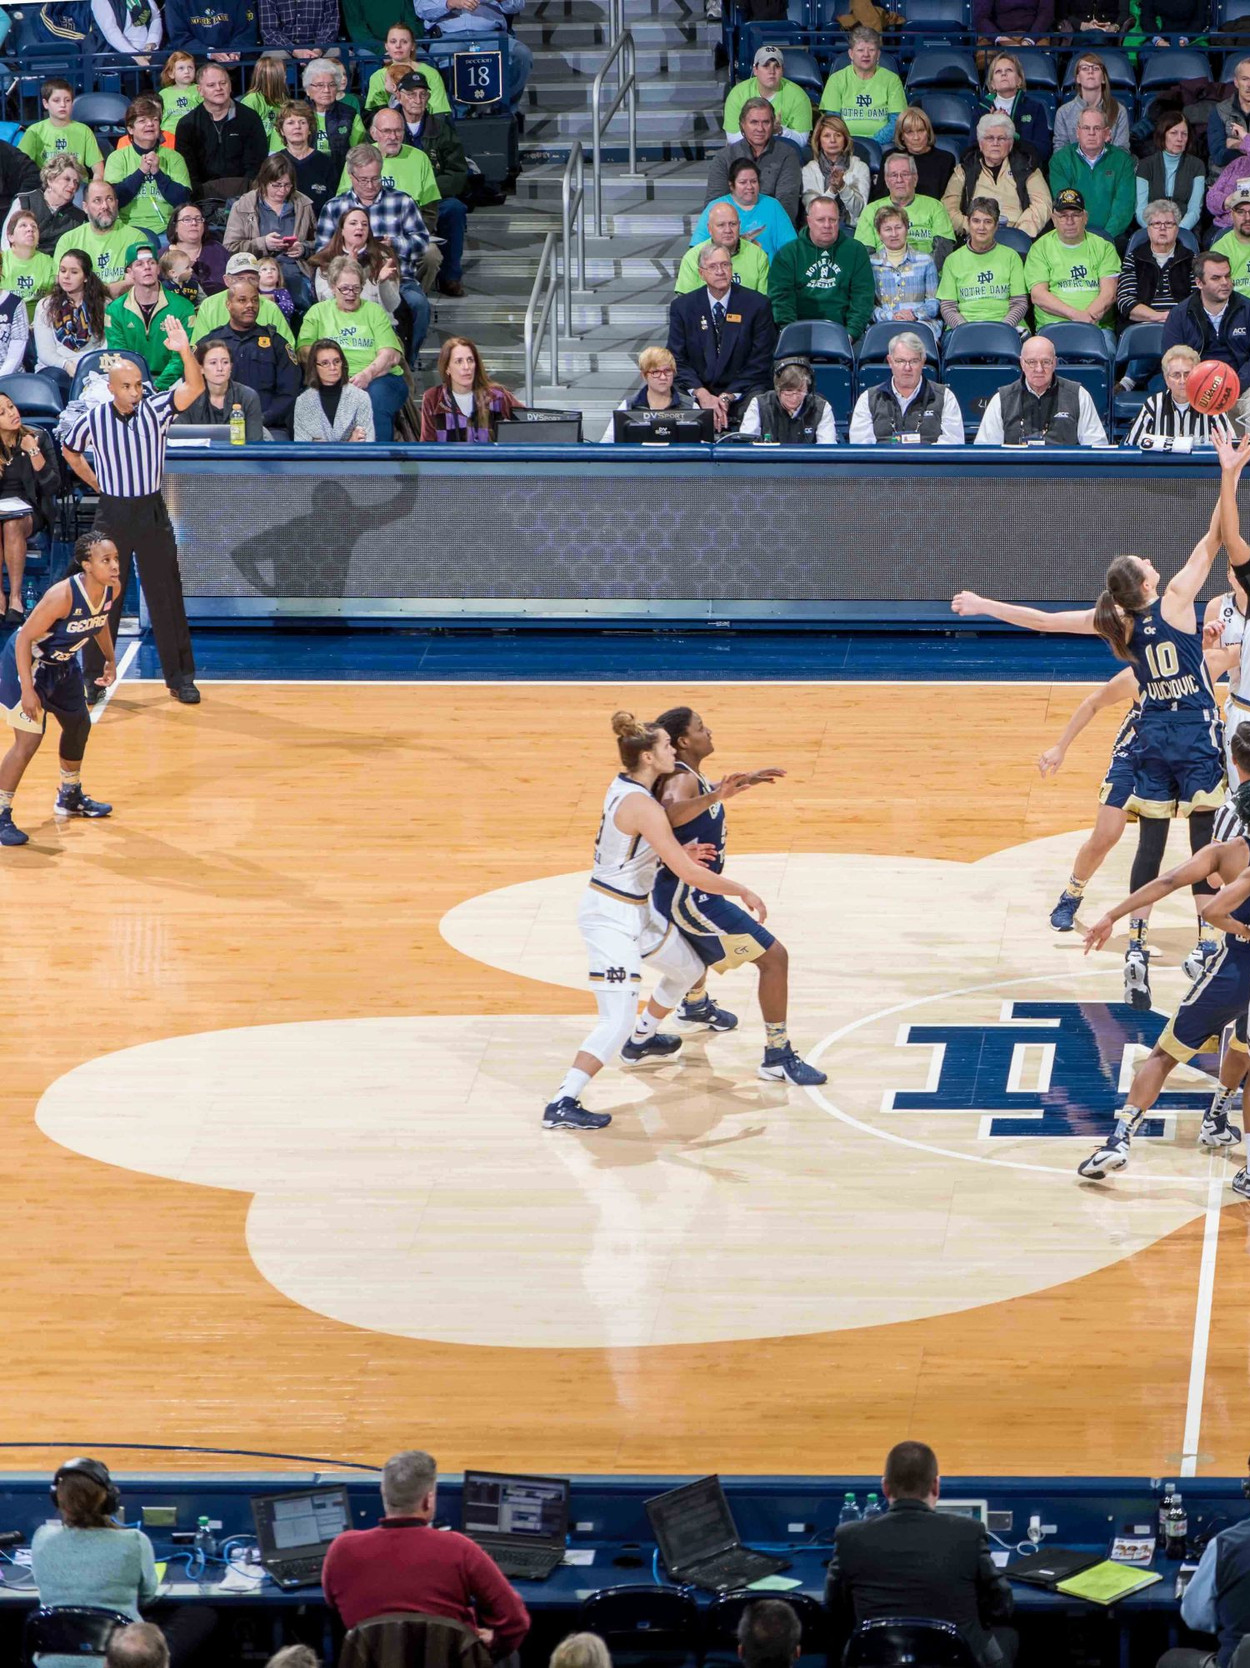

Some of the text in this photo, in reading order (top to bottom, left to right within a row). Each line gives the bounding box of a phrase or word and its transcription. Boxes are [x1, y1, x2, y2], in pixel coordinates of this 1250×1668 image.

[467, 66, 490, 87] 18
[1232, 327, 1247, 335] ACC
[1145, 641, 1180, 679] 10
